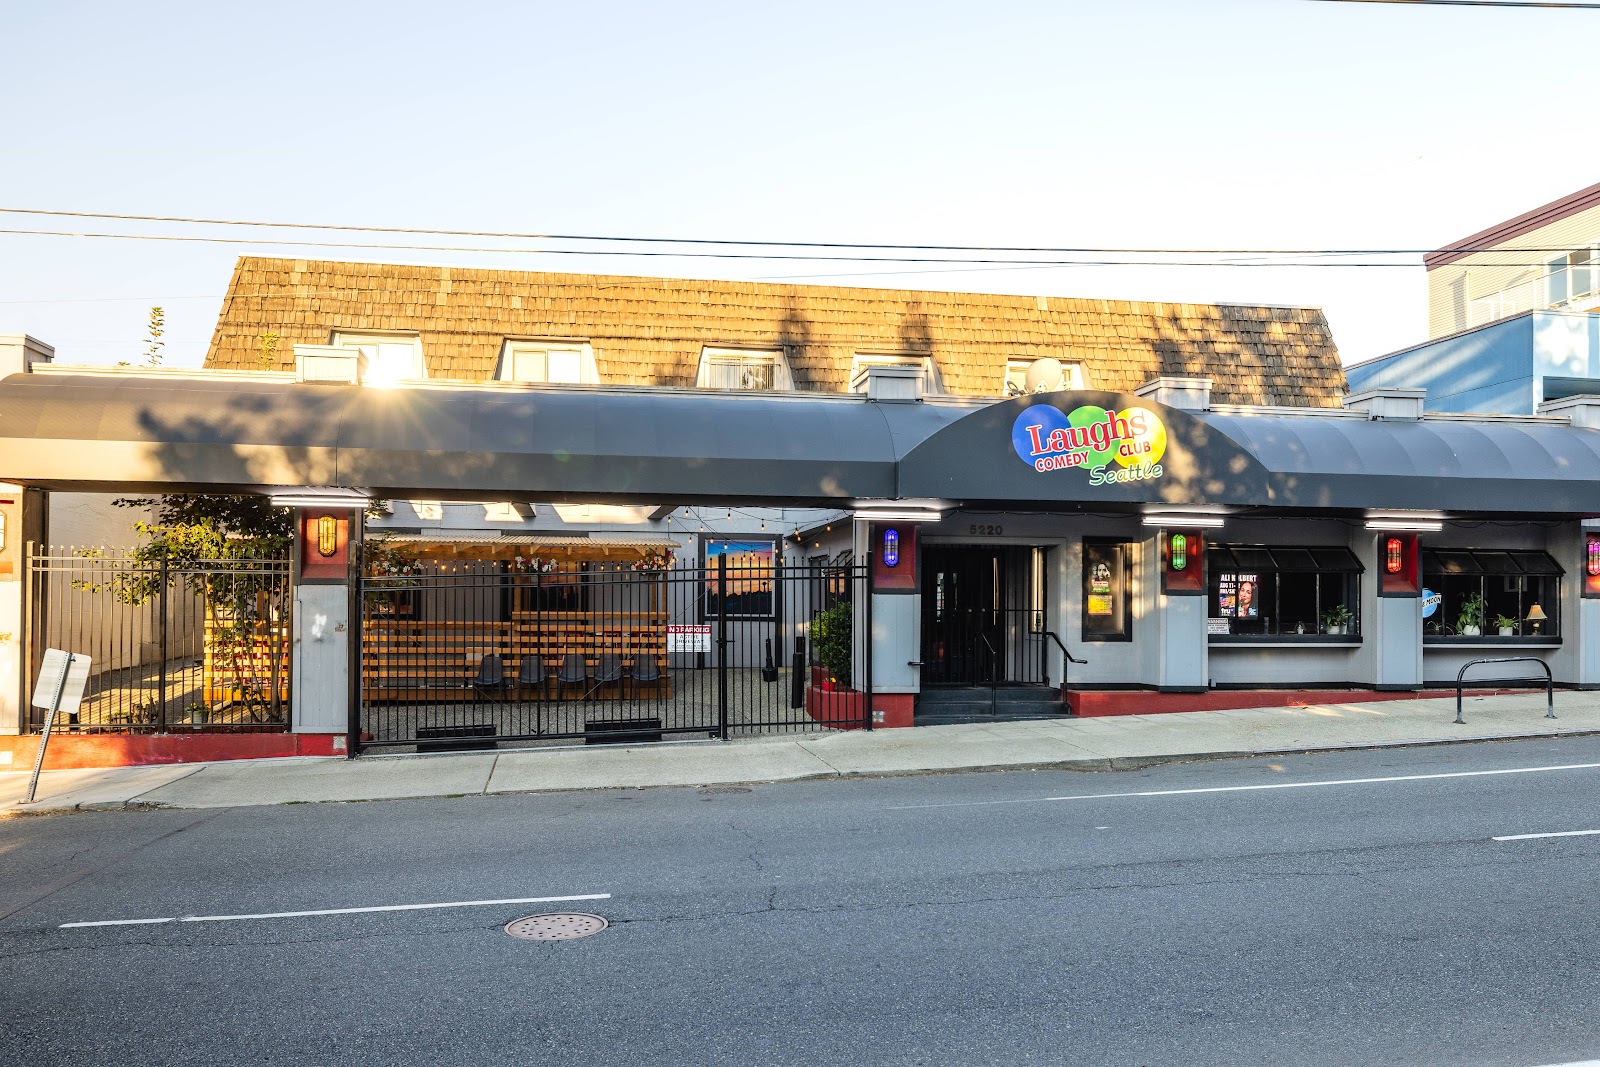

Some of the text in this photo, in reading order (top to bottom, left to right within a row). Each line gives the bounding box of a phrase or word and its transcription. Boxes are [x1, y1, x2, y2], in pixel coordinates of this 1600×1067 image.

[1026, 410, 1148, 455] Laughs
[1035, 441, 1151, 472] COMEDY CLUB
[1089, 461, 1163, 486] Seattle
[969, 524, 1003, 536] 5220
[1221, 574, 1257, 582] ALI KLBERT
[1426, 597, 1440, 605] MOON
